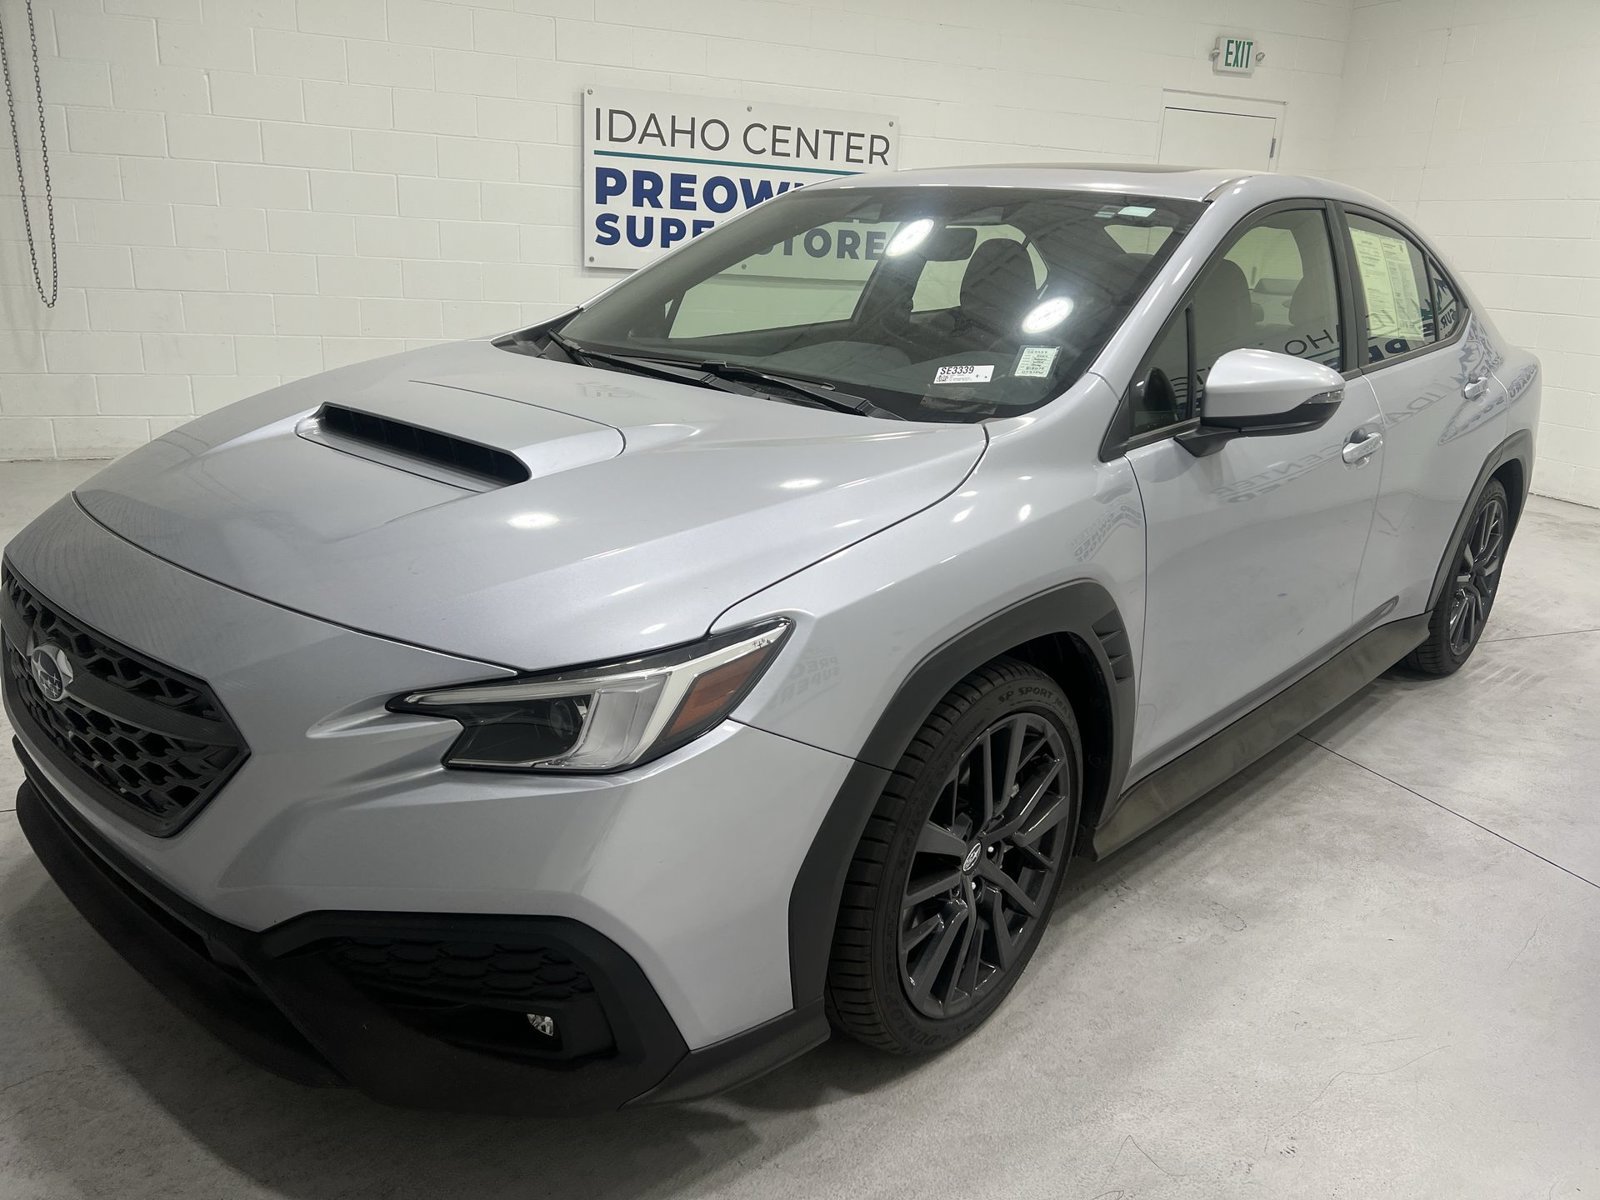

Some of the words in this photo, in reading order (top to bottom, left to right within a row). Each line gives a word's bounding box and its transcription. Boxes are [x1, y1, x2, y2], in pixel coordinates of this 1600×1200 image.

[1224, 39, 1254, 69] EXIT
[595, 107, 730, 151] IDAHO
[742, 122, 890, 166] CENTER
[595, 166, 804, 214] PREOW
[940, 365, 975, 375] SE3339
[1018, 686, 1054, 699] SPORT
